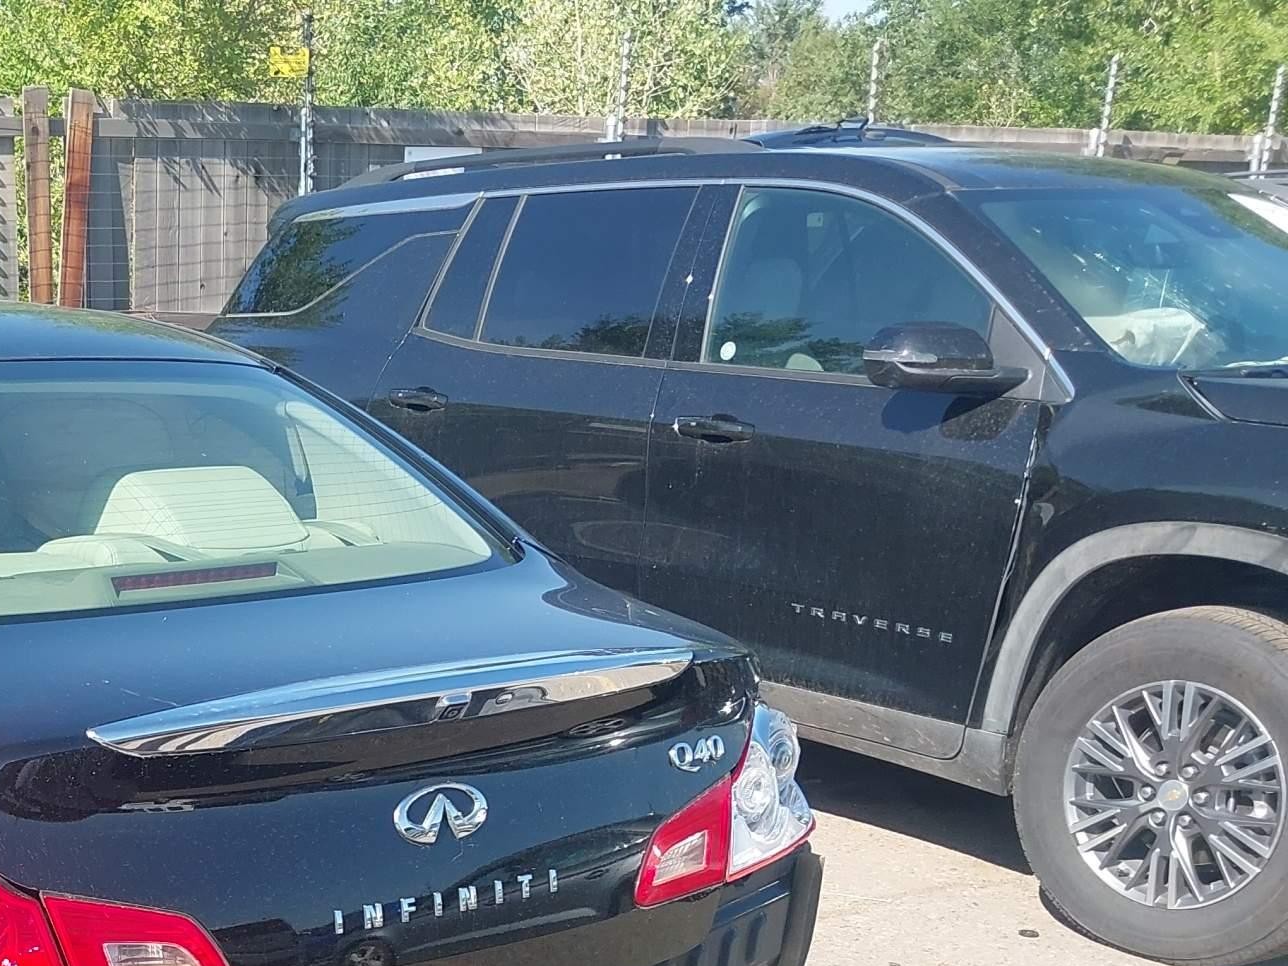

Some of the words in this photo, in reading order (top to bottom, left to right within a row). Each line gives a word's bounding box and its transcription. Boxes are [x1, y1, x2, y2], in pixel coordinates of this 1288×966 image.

[790, 602, 953, 643] TRAVERSE
[668, 735, 726, 773] Q40
[333, 869, 559, 935] INFINITI
